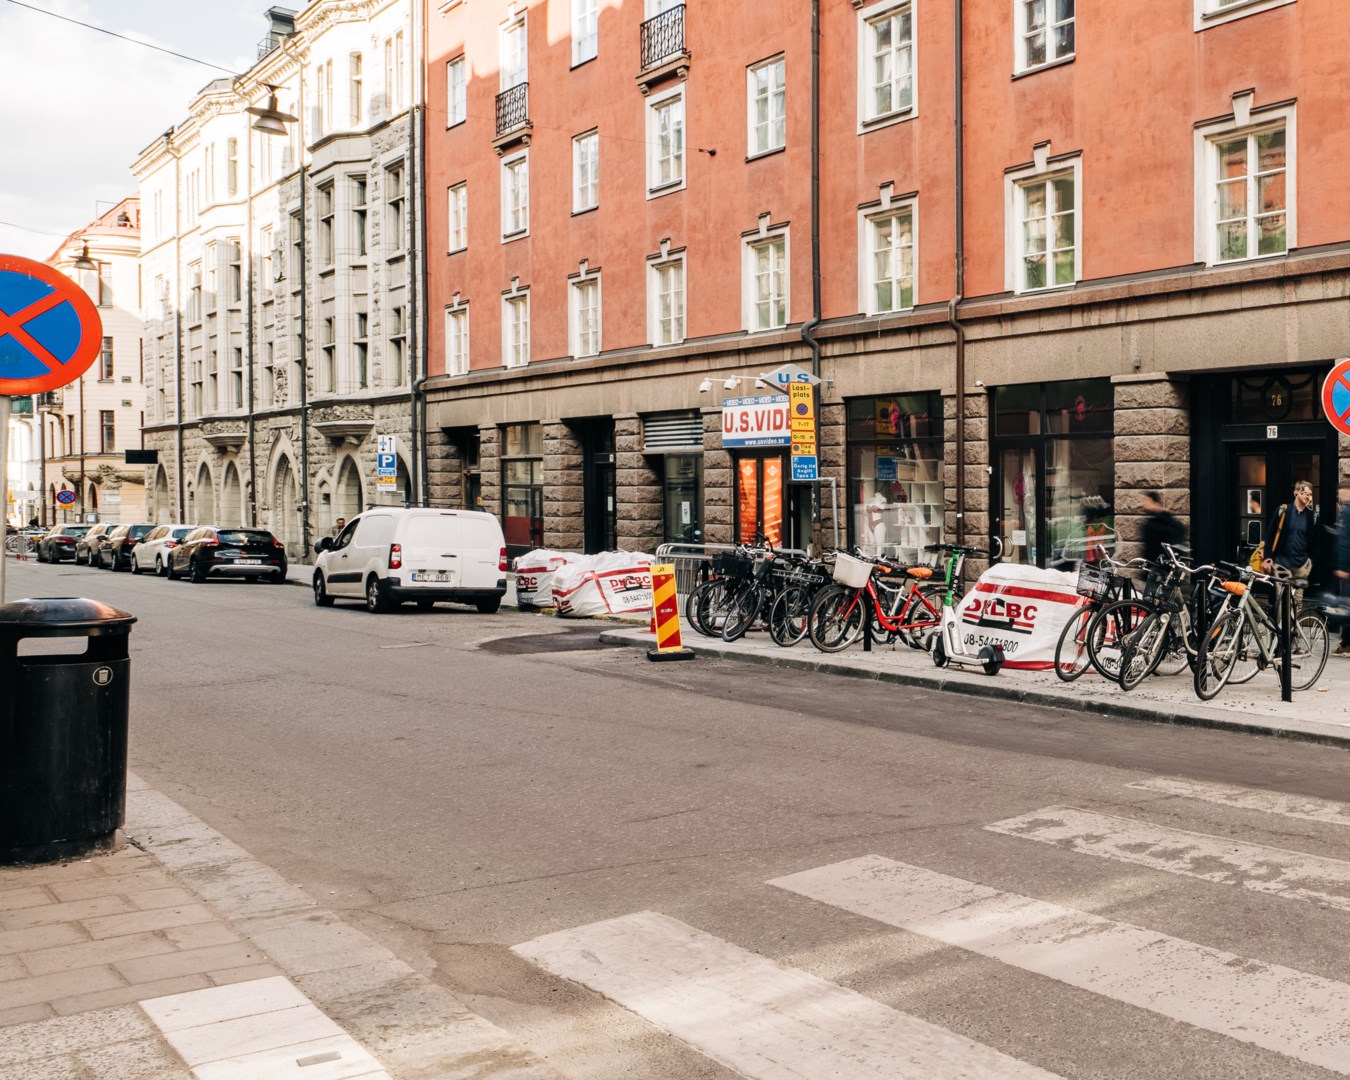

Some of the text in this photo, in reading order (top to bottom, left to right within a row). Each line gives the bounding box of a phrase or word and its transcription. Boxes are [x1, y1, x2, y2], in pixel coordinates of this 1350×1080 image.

[1271, 394, 1281, 406] 76
[724, 409, 791, 433] U.S.VIDE
[1268, 428, 1276, 436] 76
[518, 576, 537, 586] LBC
